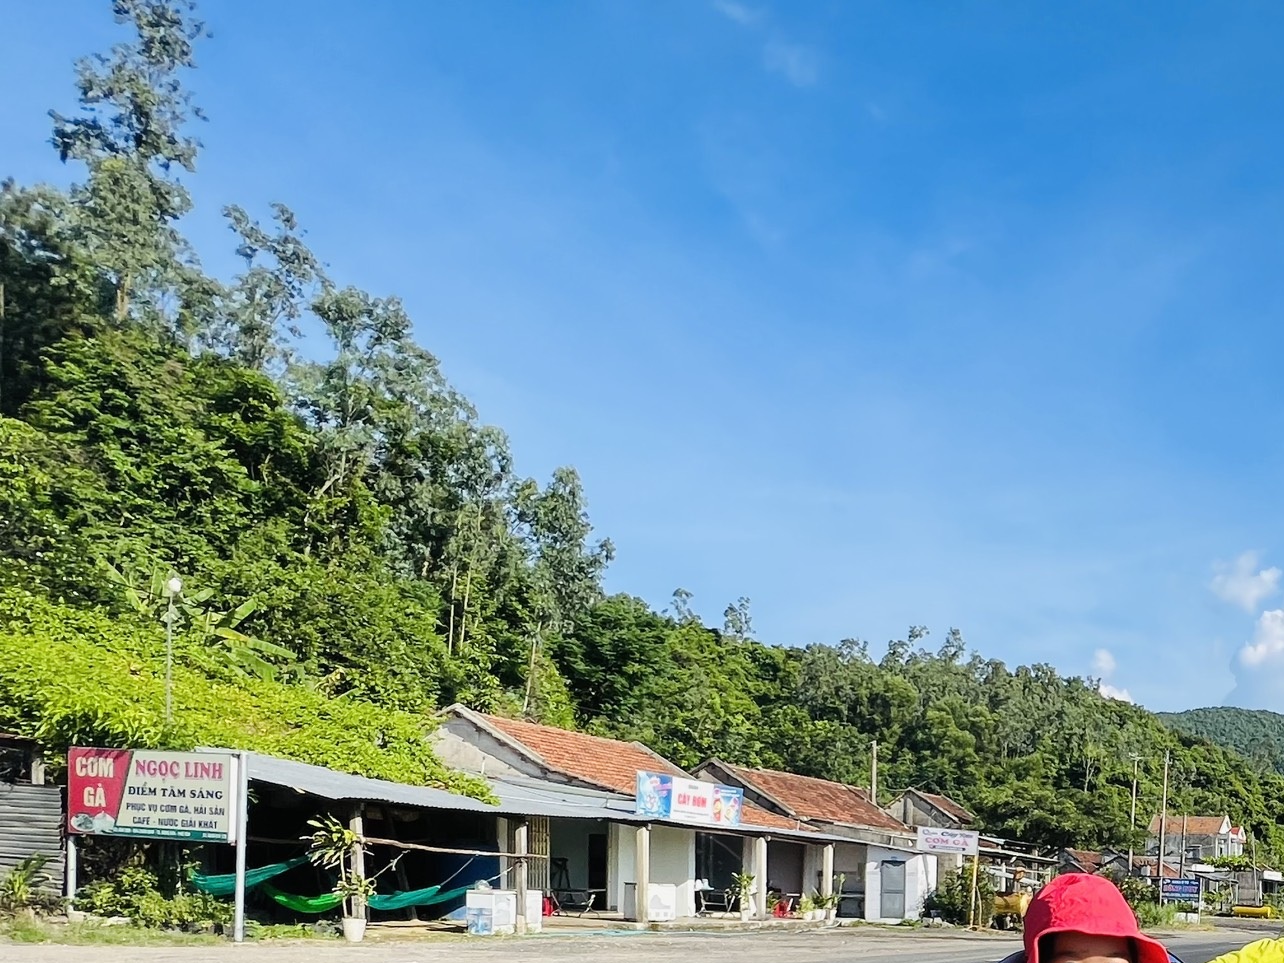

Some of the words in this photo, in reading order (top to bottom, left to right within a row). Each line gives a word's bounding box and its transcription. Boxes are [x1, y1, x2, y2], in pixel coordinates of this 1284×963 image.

[135, 759, 180, 784] NGỌC
[184, 761, 223, 781] LINH
[83, 783, 106, 808] GÀ
[189, 787, 223, 800] SÁNG
